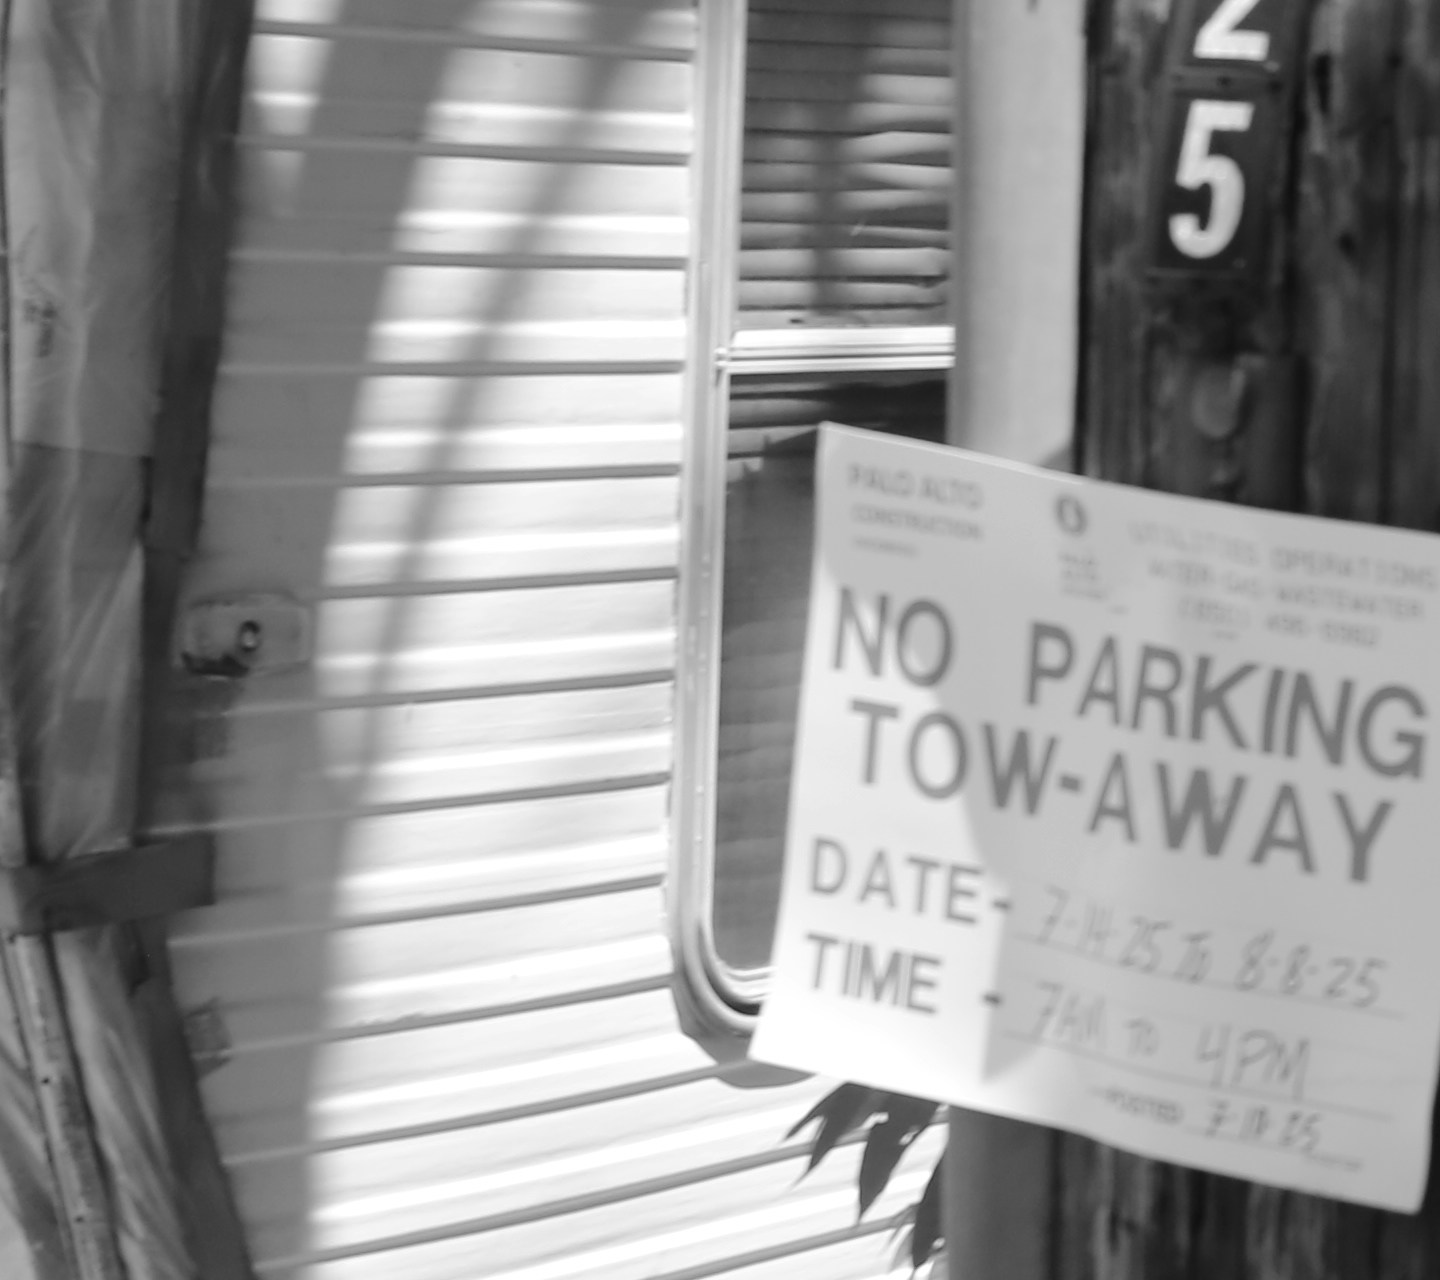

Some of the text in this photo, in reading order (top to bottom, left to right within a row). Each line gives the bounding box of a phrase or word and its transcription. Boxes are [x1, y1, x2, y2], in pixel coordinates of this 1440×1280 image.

[831, 586, 1429, 781] NO PARKING
[850, 696, 1395, 885] TOW-AWAY
[804, 932, 942, 1017] TIME
